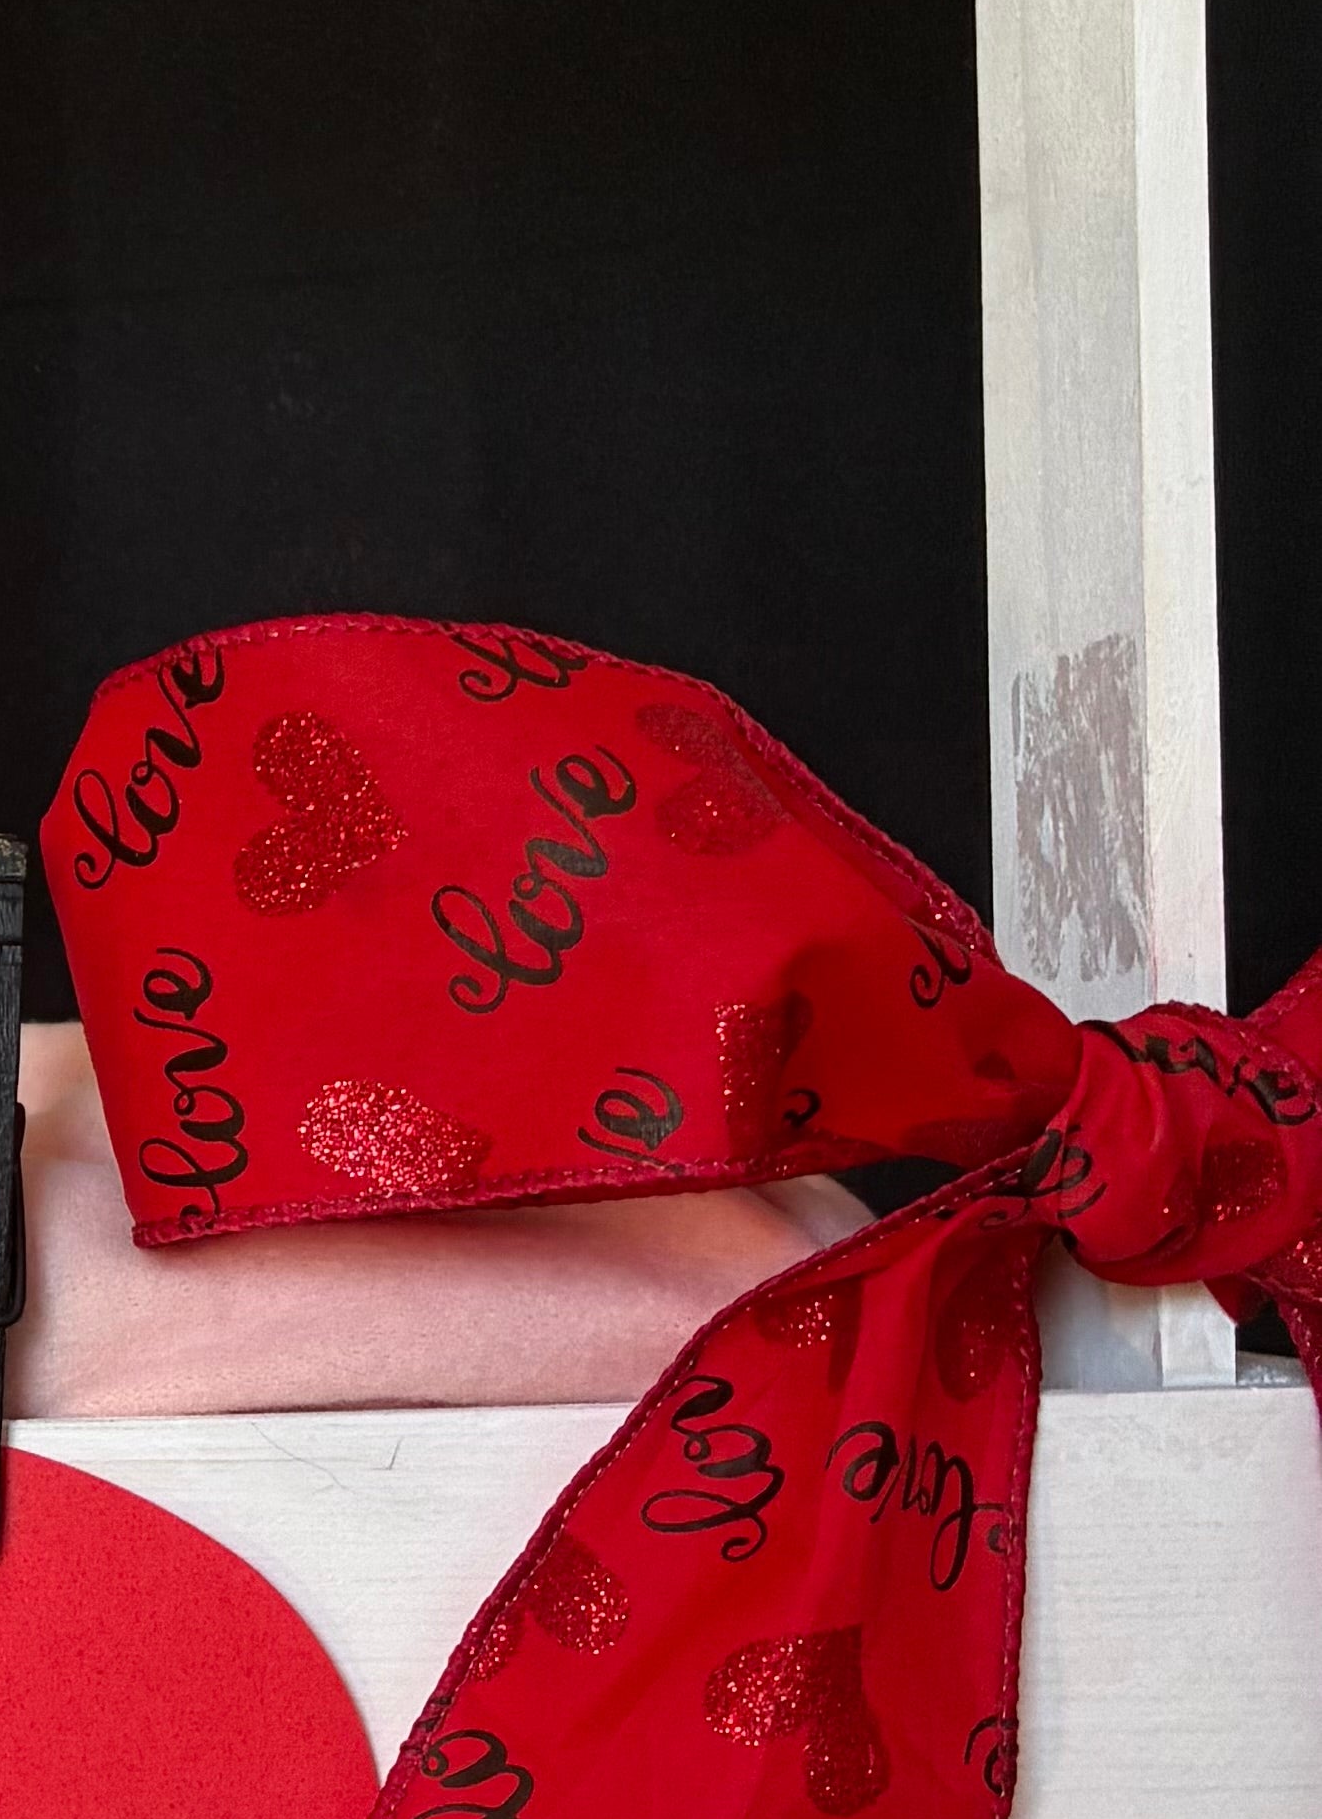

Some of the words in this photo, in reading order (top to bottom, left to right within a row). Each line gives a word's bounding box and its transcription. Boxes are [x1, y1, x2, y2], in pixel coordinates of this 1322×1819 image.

[430, 744, 638, 1015] love
[132, 947, 249, 1231] love
[640, 1373, 785, 1563] lov
[827, 1419, 1011, 1593] love
